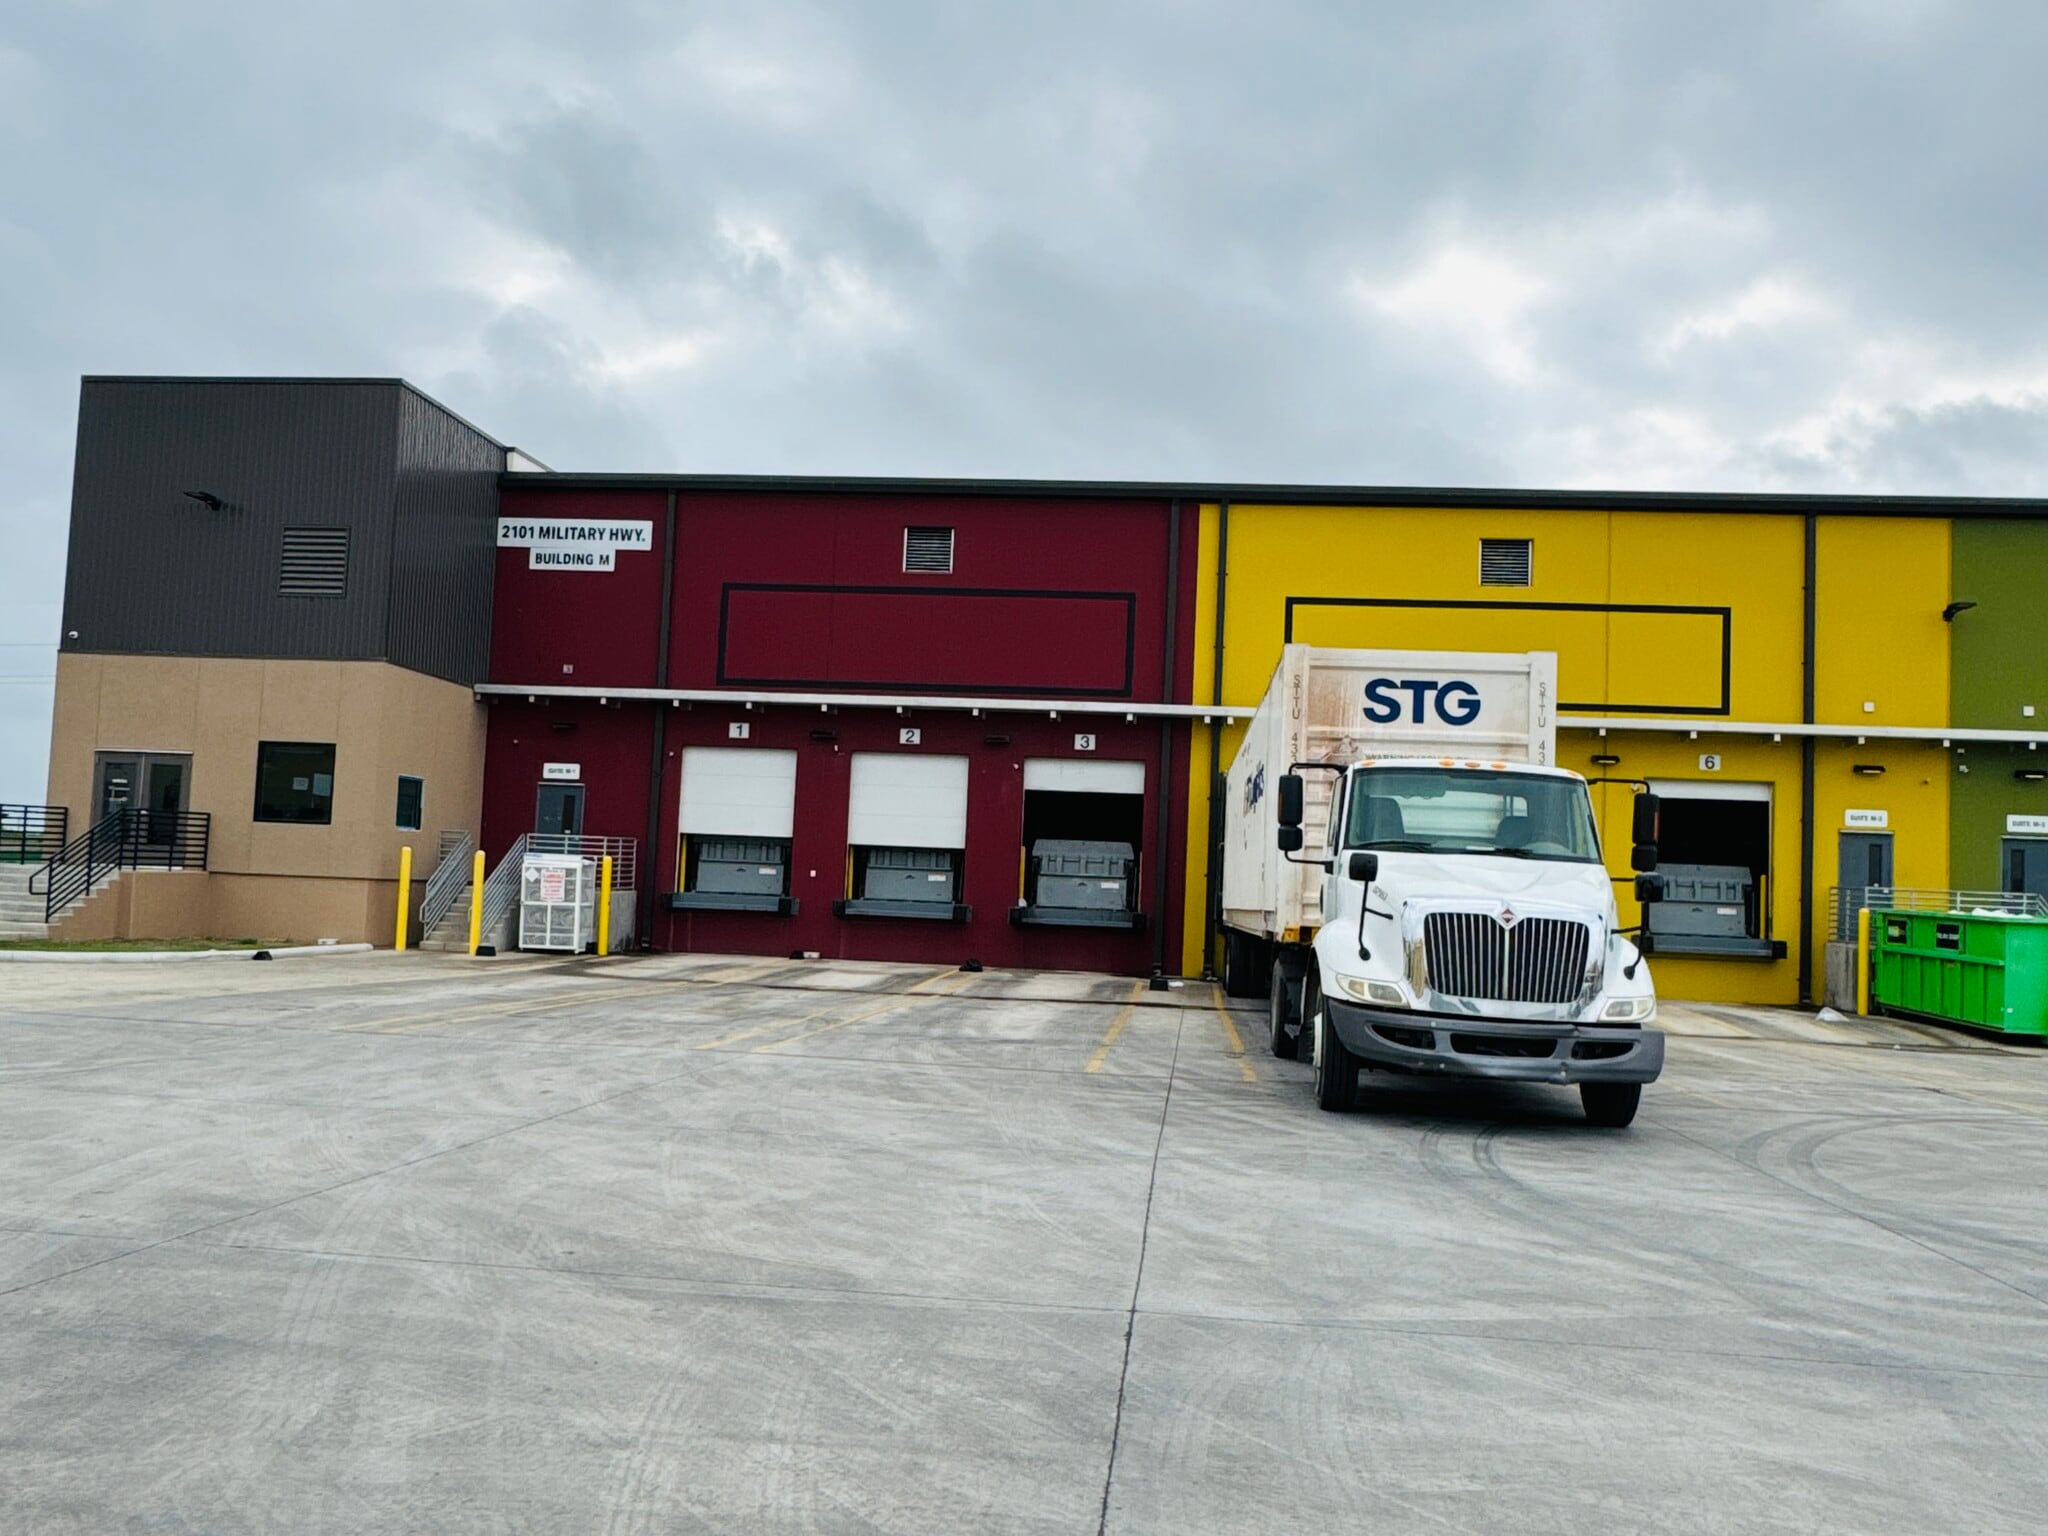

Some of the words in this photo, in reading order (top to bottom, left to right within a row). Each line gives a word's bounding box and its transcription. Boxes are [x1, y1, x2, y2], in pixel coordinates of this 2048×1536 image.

[501, 525, 534, 539] 2101
[538, 526, 606, 541] MILITARY
[609, 528, 646, 542] HWY.
[535, 553, 593, 565] BUILDING
[599, 554, 610, 566] M
[1292, 674, 1301, 719] STTU
[1362, 678, 1482, 727] STG
[1538, 682, 1546, 728] STTU
[735, 724, 743, 737] 1
[905, 730, 915, 742] 2
[1080, 735, 1090, 748] 3
[1704, 755, 1715, 769] 6
